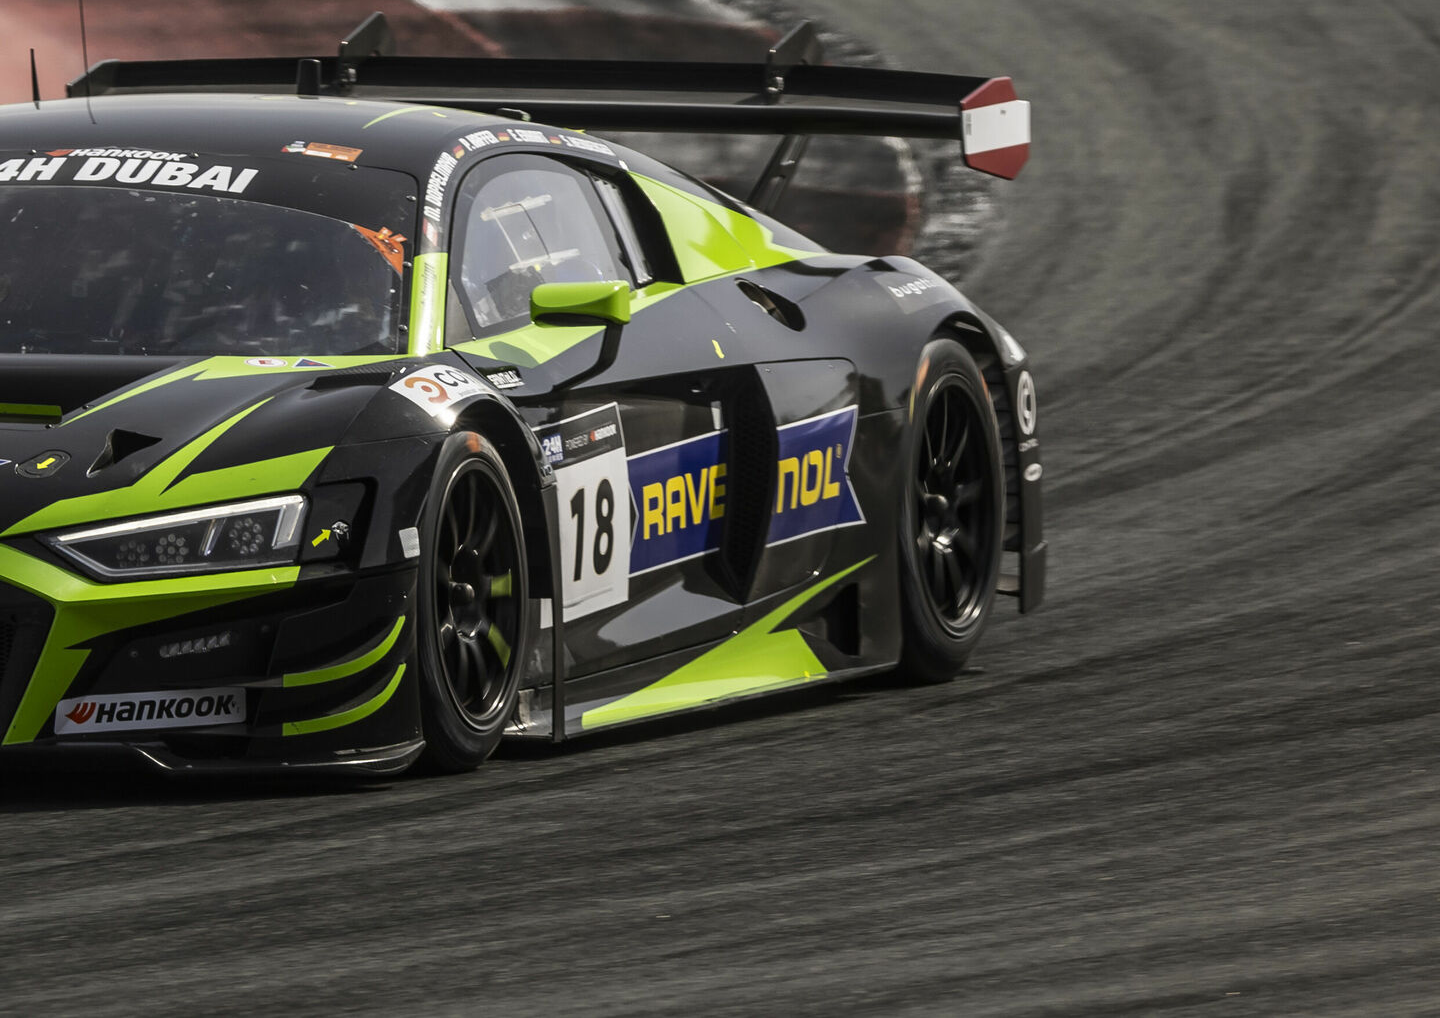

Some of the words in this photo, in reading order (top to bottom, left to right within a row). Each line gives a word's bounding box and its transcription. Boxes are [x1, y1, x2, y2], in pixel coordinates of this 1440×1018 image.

[68, 148, 189, 162] HANKOOK
[72, 157, 259, 193] DUBAI
[543, 434, 562, 456] 24H
[570, 478, 615, 583] 18
[95, 694, 235, 724] HANKOOK
